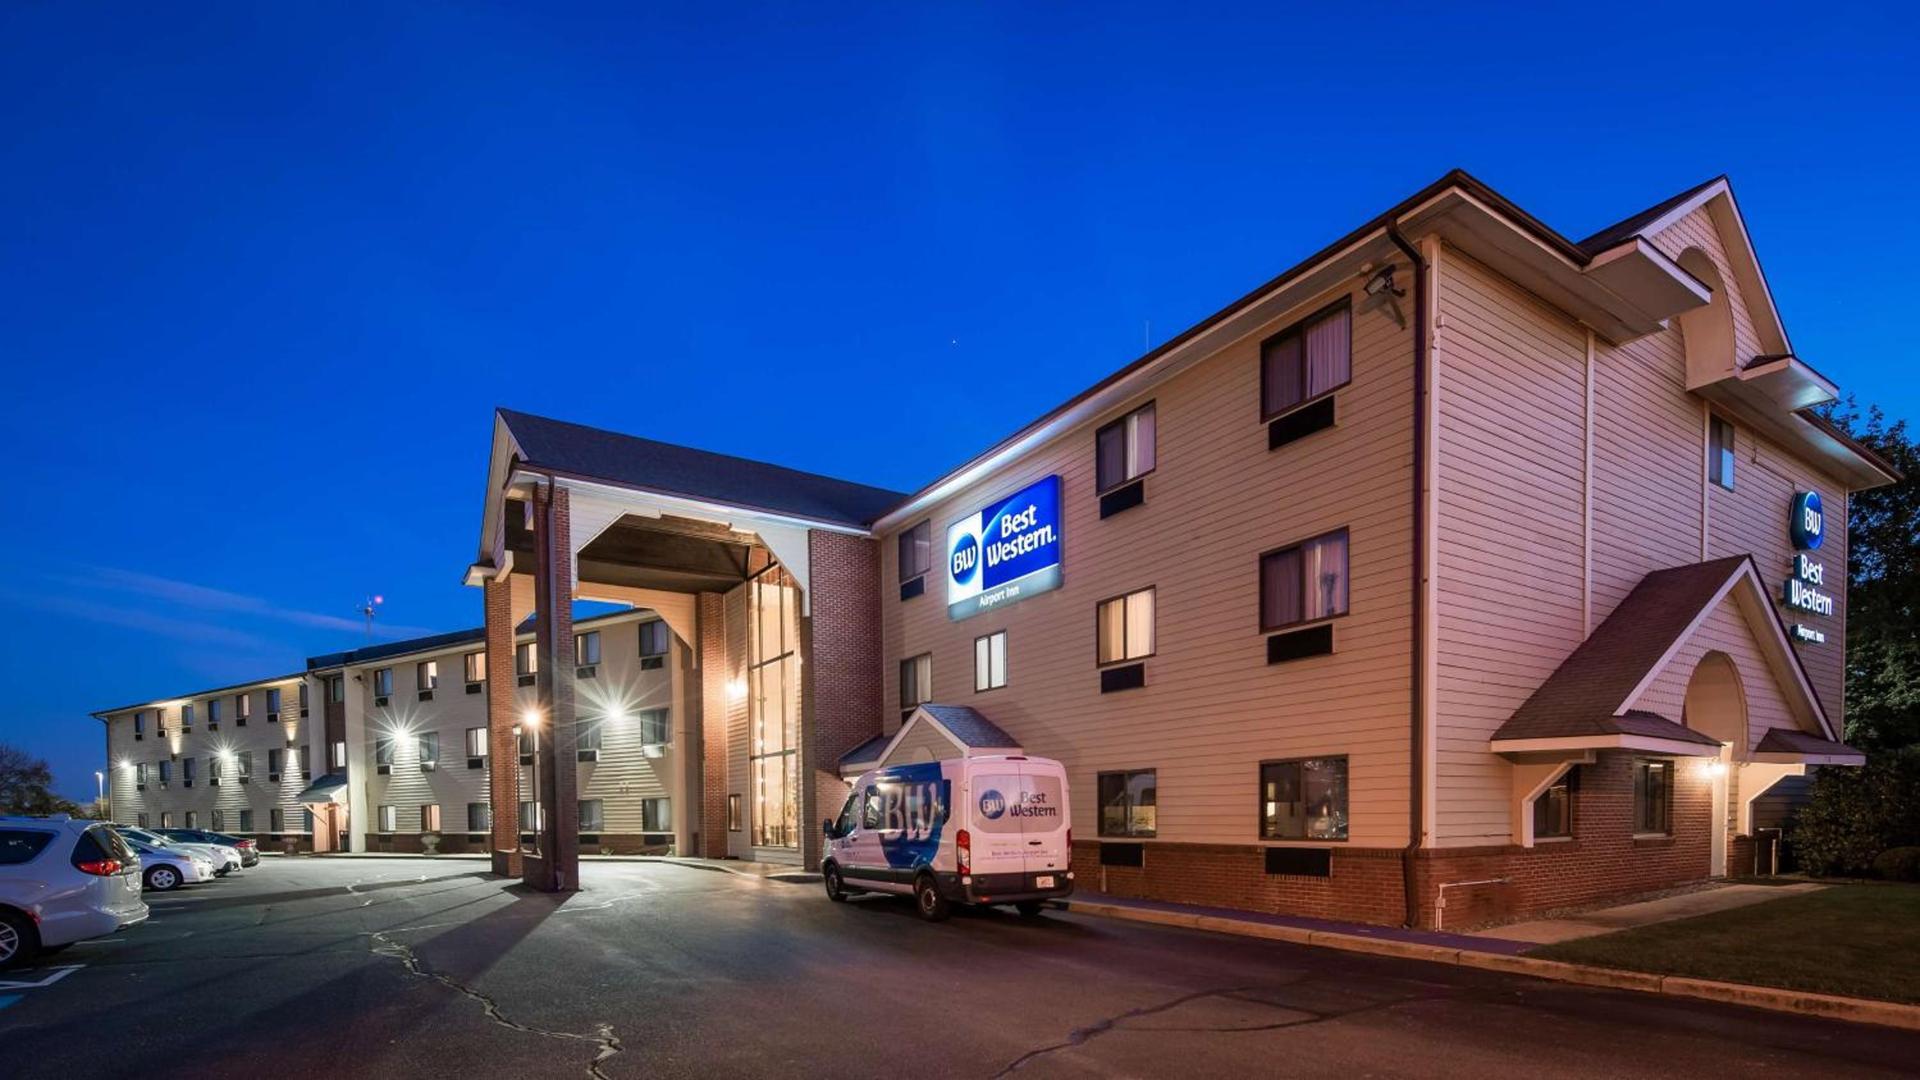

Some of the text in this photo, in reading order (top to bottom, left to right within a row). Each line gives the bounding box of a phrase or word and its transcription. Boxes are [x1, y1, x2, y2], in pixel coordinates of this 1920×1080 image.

[1001, 503, 1037, 538] Best
[1804, 507, 1822, 536] BW
[953, 545, 976, 575] BW
[1801, 554, 1824, 585] Best
[979, 590, 1005, 608] Airport
[1791, 579, 1833, 616] Western
[884, 782, 937, 841] BW
[982, 798, 1004, 813] BW
[1010, 804, 1057, 817] Western
[1021, 791, 1047, 804] Best
